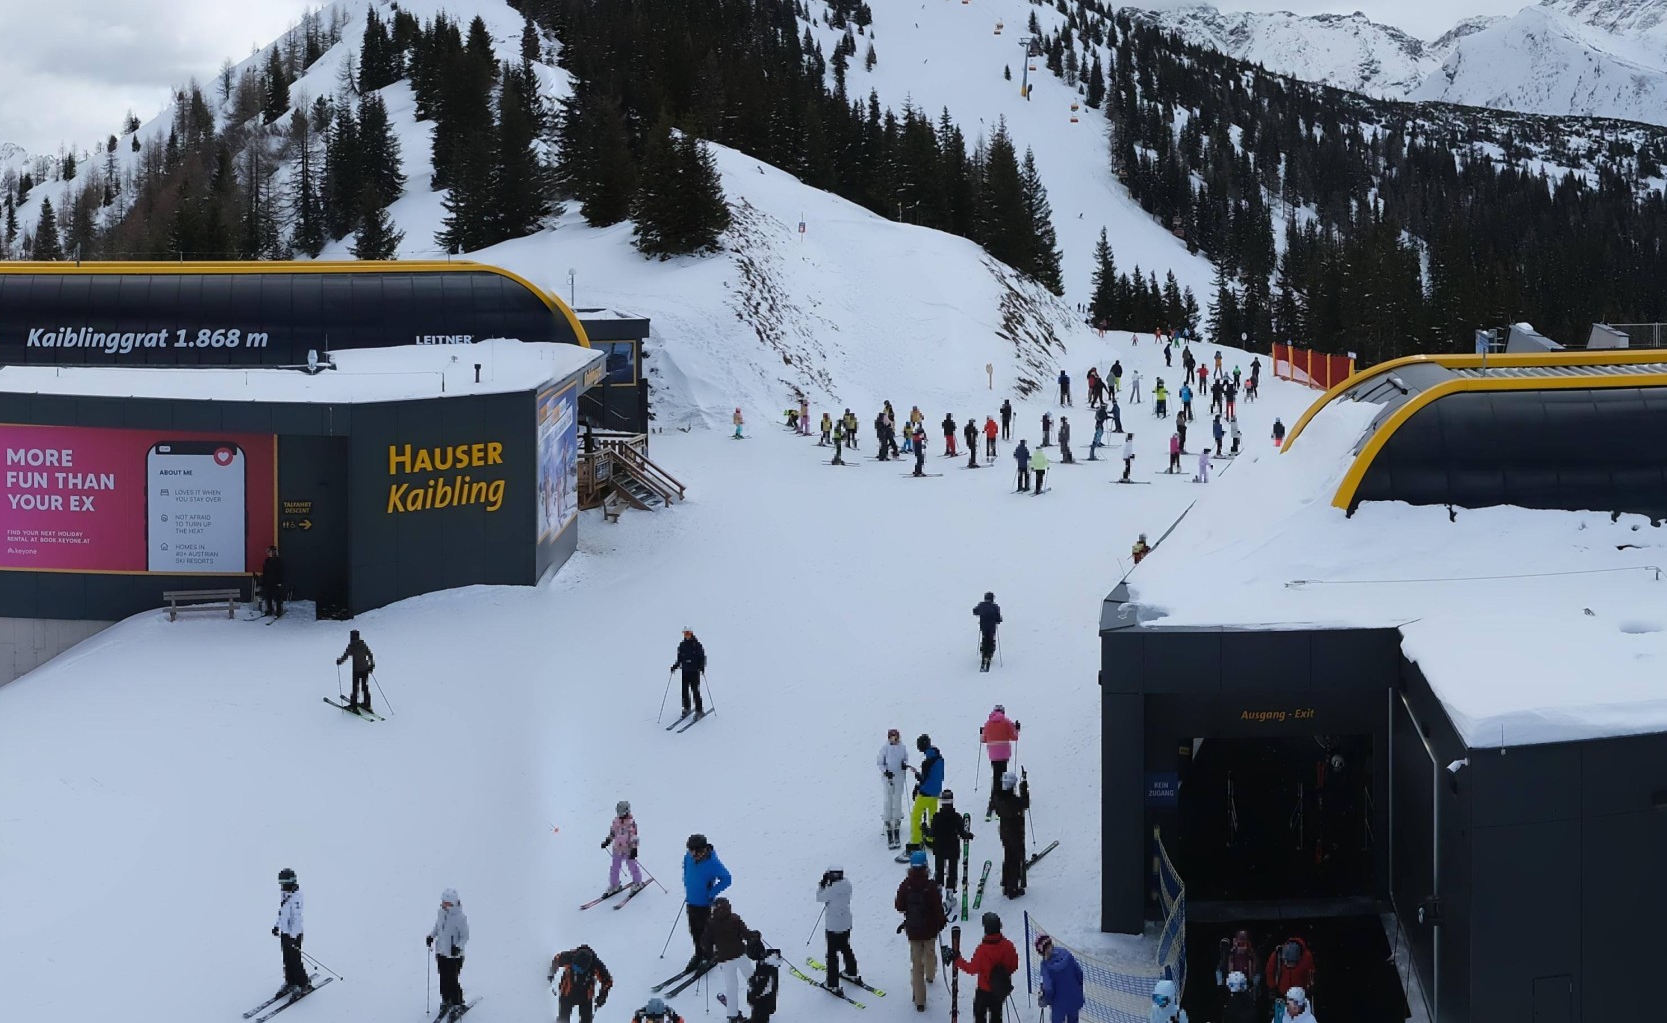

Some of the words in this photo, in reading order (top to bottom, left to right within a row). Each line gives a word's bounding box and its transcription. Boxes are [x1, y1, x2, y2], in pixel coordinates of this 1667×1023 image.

[26, 327, 169, 354] Kaiblinggrat
[173, 328, 241, 348] 1.868
[246, 332, 269, 348] m
[6, 448, 73, 467] MORE
[388, 442, 504, 475] HAUSER
[6, 471, 48, 489] FUN
[55, 473, 115, 490] THAN
[8, 494, 63, 511] YOUR
[70, 495, 95, 512] EX
[387, 476, 506, 514] Kaibling
[1241, 710, 1286, 722] Ausgang
[1294, 708, 1315, 719] Exit
[1149, 789, 1174, 797] ZUGANG
